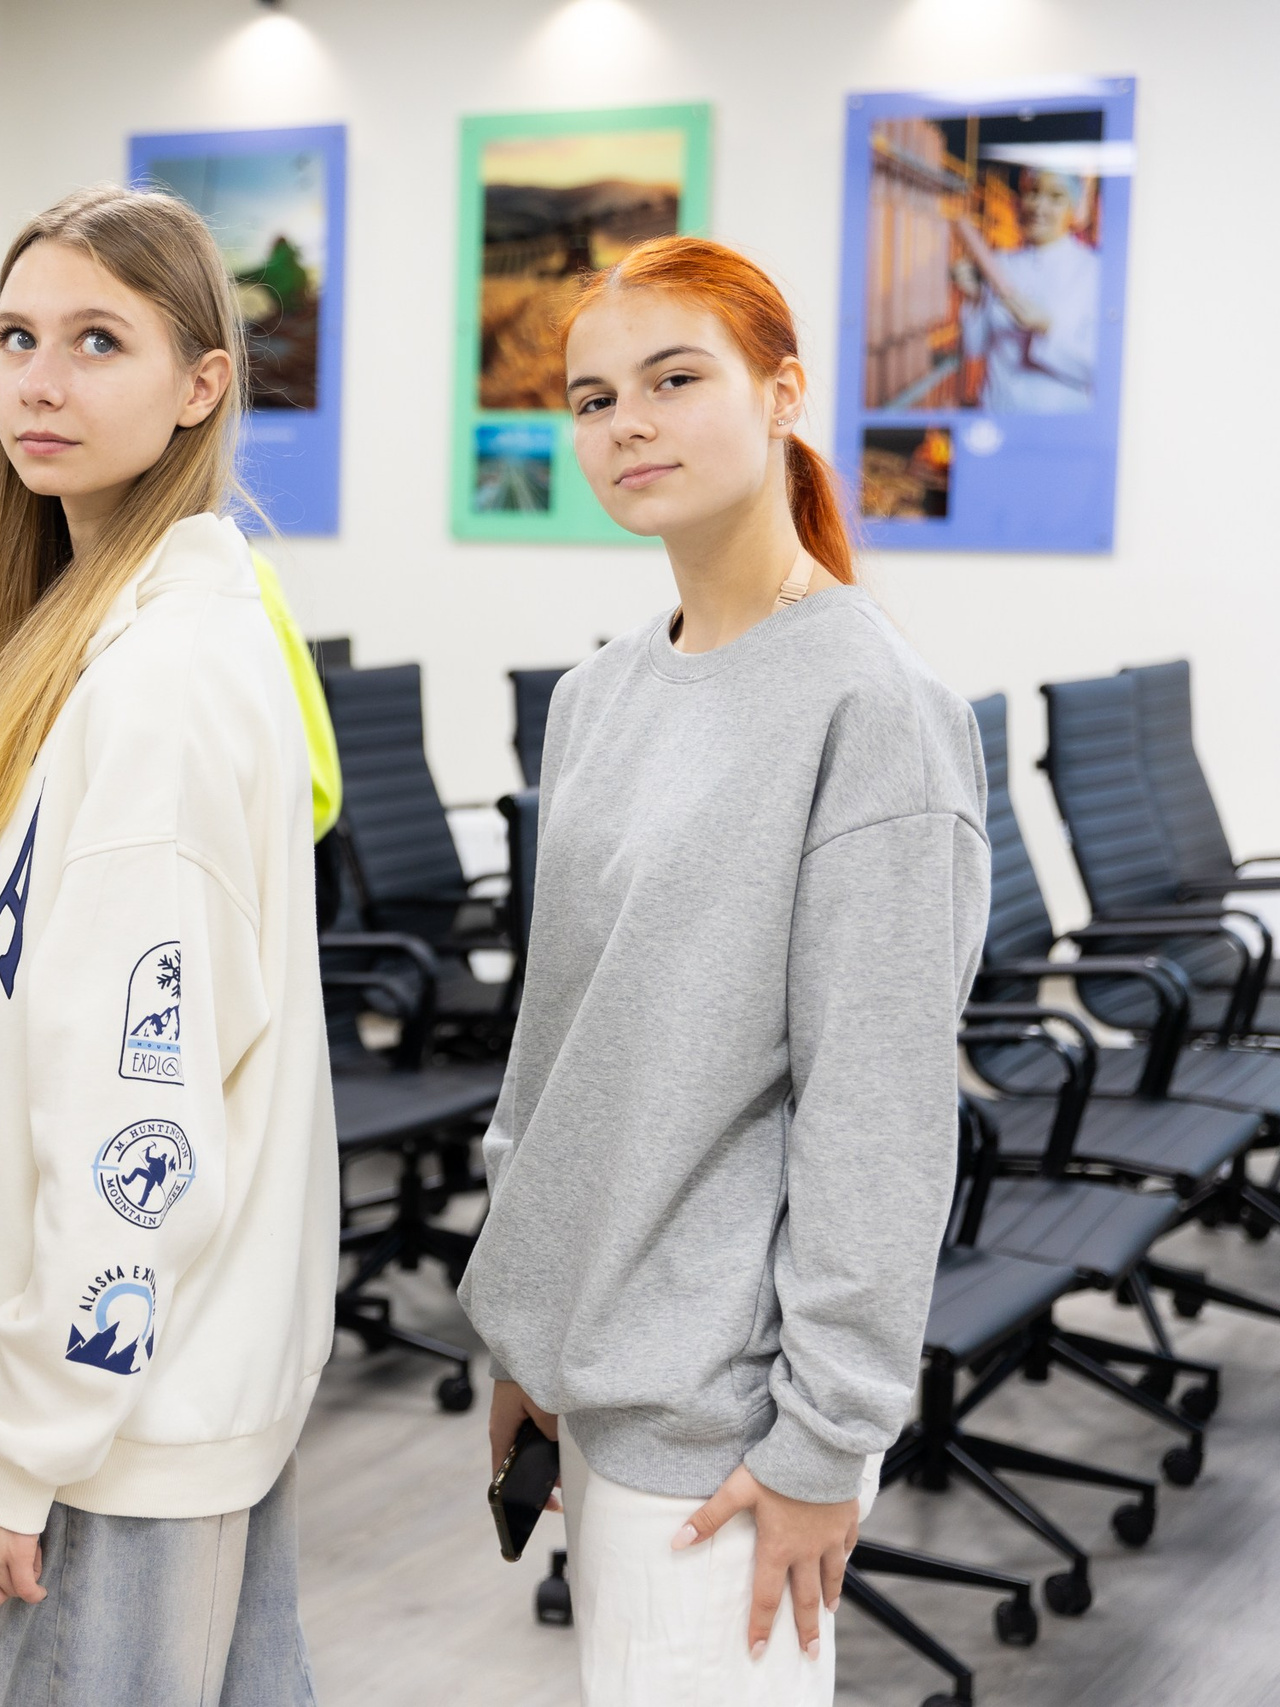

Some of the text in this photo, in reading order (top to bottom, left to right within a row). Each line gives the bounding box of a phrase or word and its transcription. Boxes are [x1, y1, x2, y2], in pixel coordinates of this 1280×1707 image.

[114, 1124, 189, 1159] M. HUNTINGTON
[106, 1178, 157, 1225] MOUNTAIN
[79, 1265, 126, 1312] ALASKA
